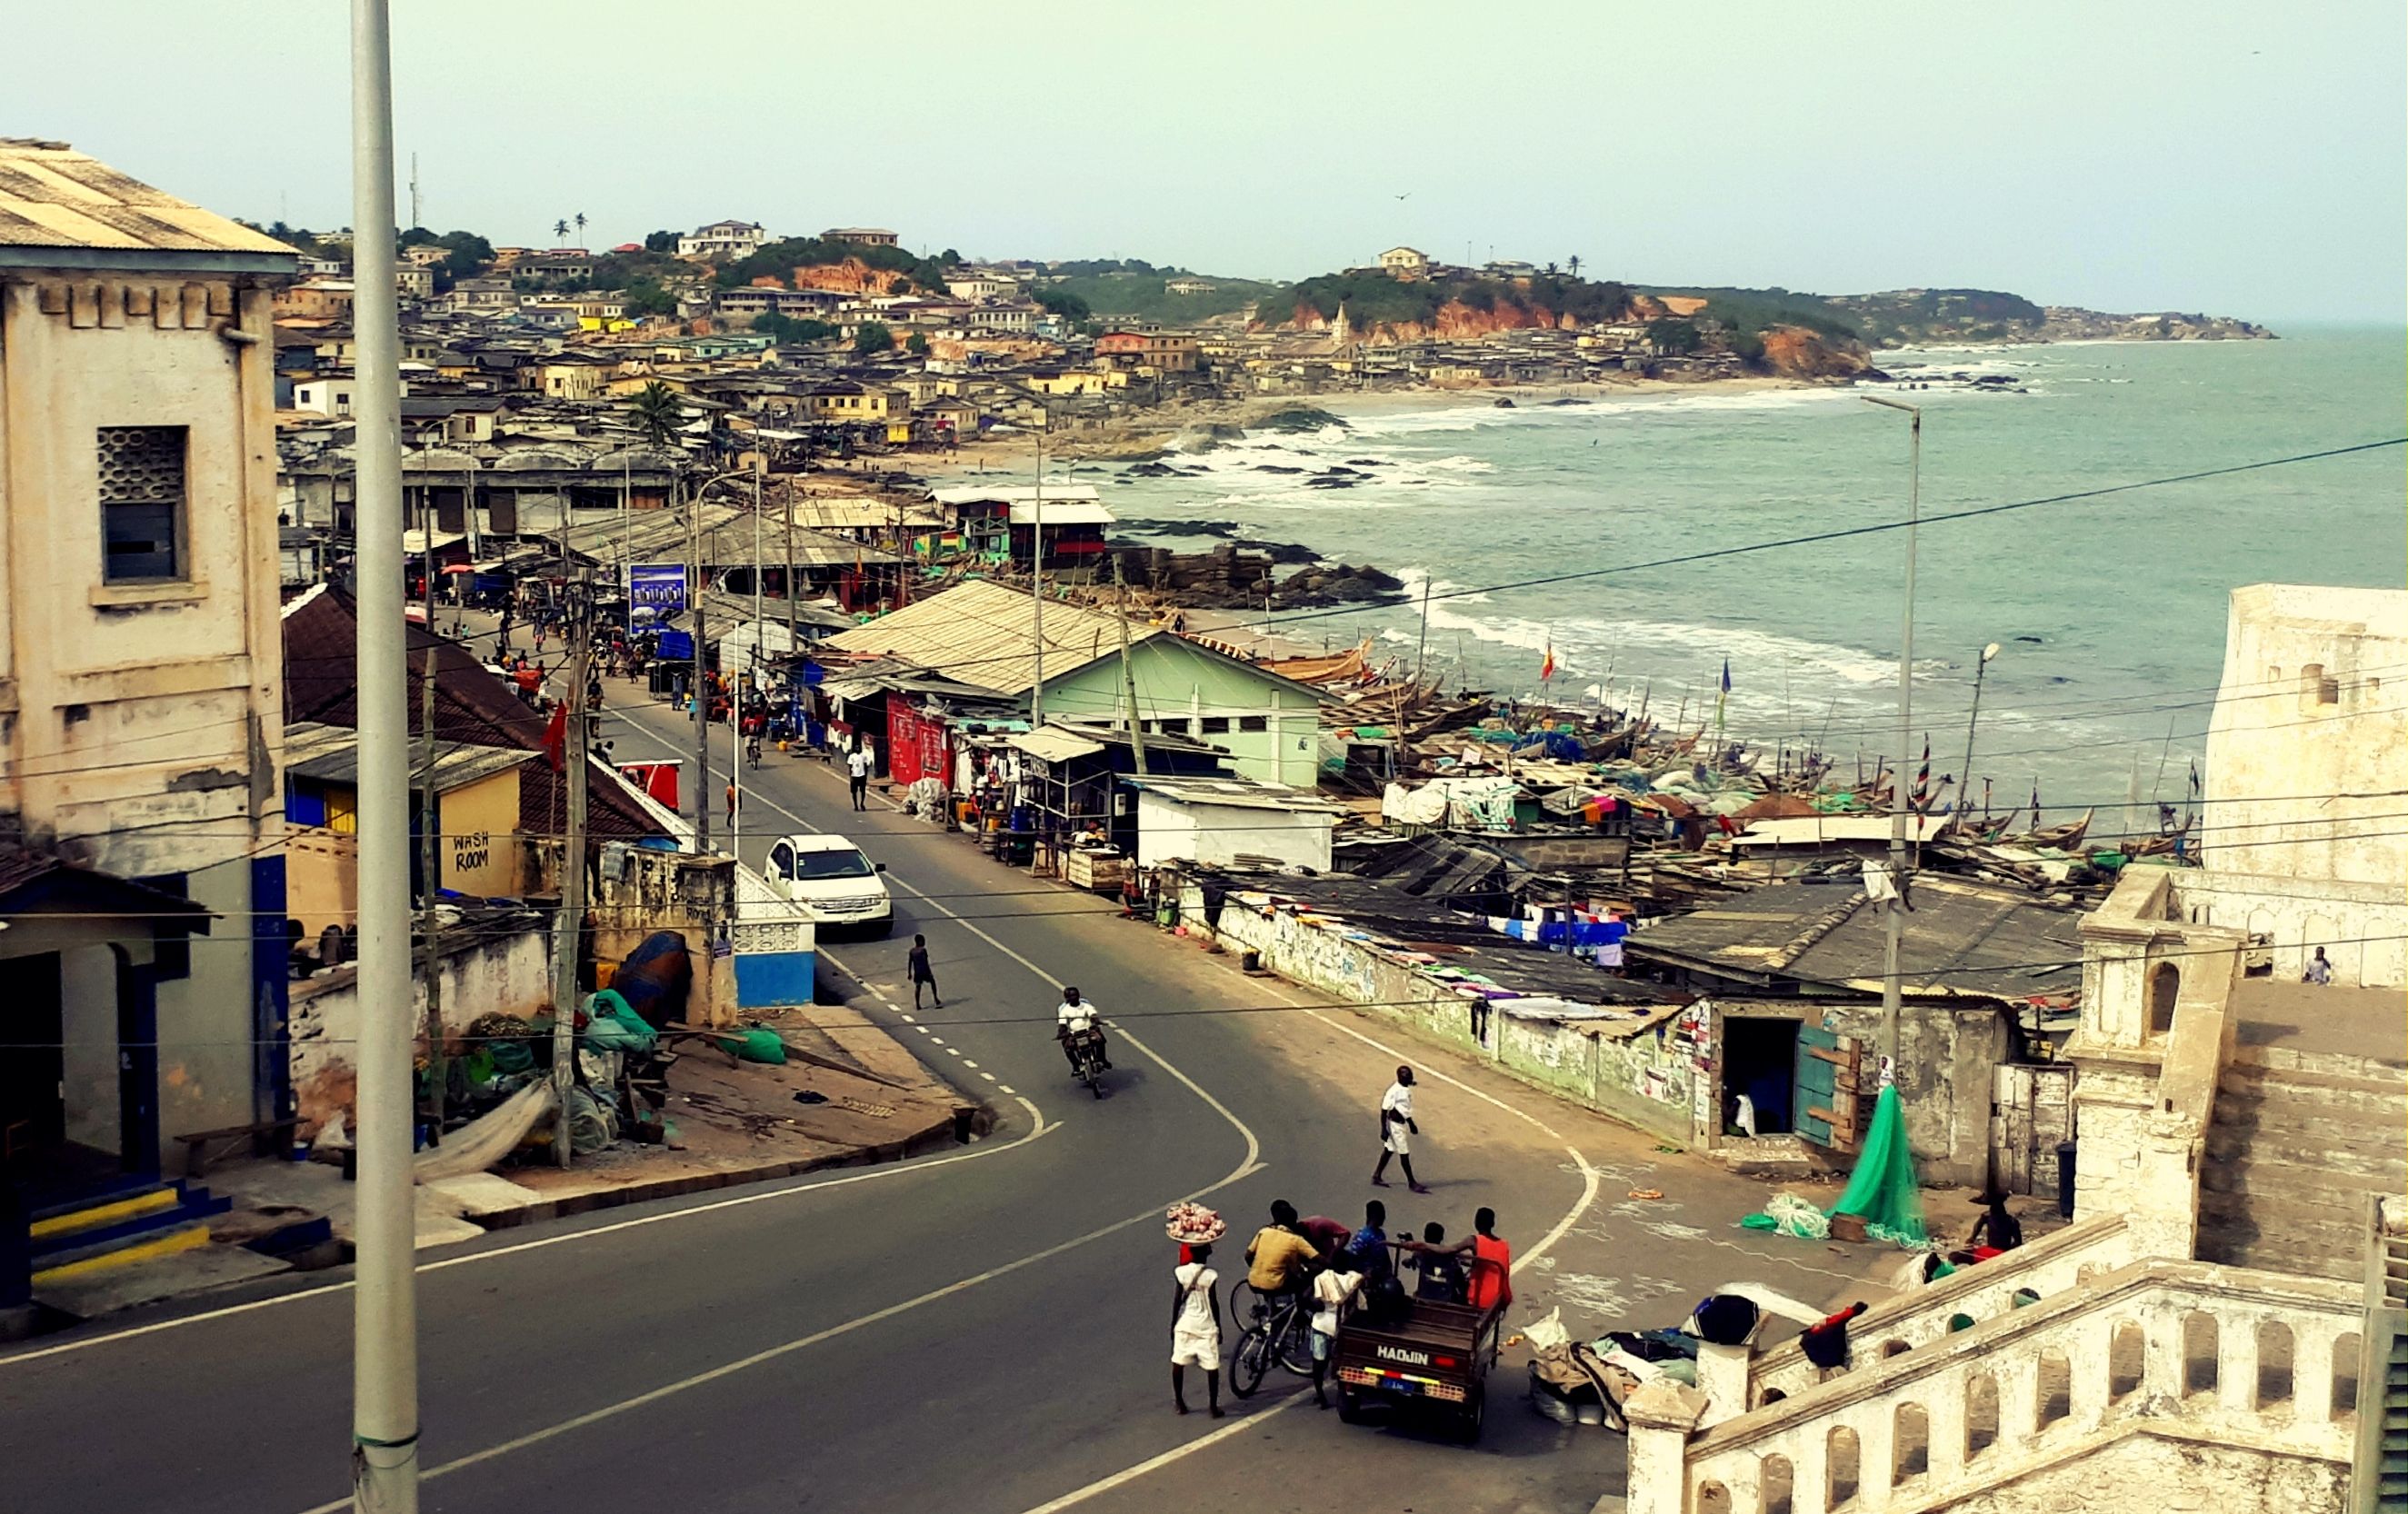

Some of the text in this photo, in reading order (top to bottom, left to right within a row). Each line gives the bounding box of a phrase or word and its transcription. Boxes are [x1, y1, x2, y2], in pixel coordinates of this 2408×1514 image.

[454, 831, 488, 851] WASH
[456, 849, 488, 872] ROOM
[1377, 1345, 1429, 1366] HAOJIN
